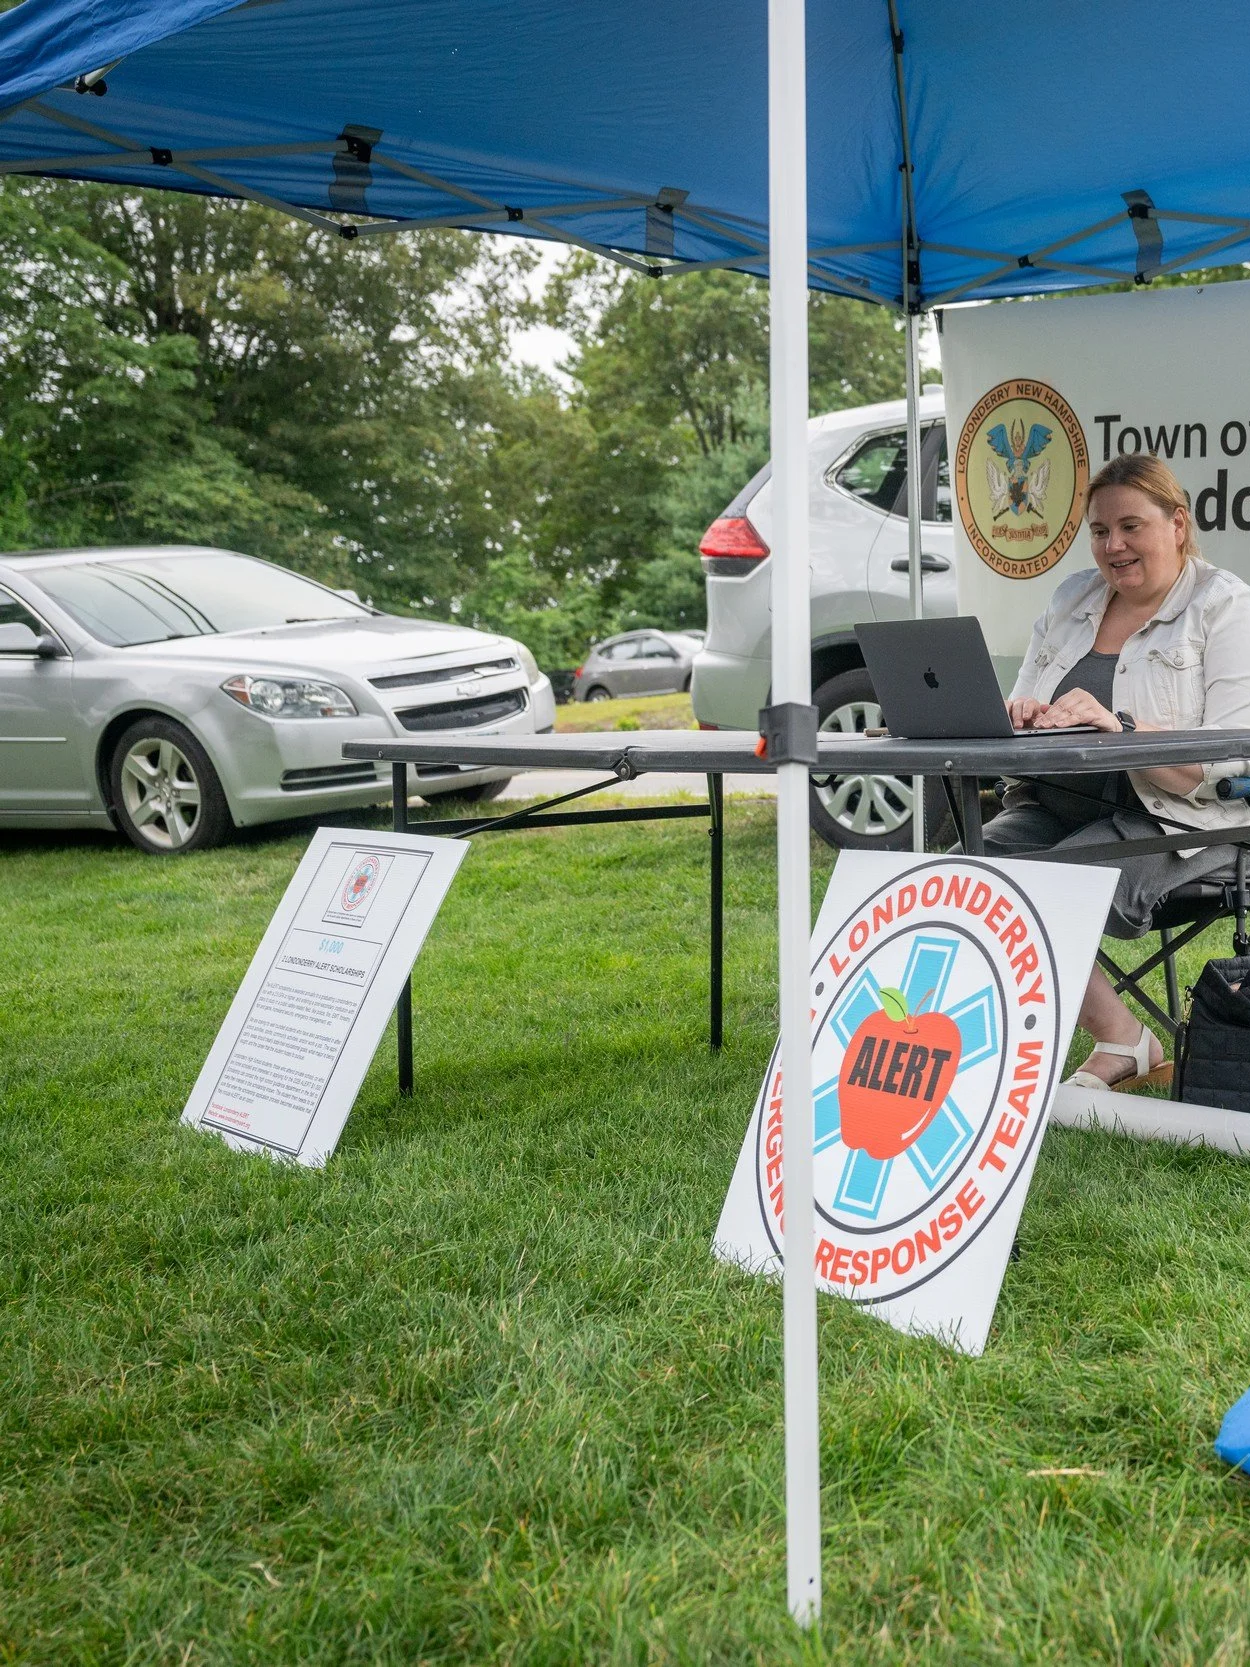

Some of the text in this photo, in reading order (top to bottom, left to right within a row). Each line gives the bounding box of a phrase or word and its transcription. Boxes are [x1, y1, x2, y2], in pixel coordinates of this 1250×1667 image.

[958, 384, 1086, 473] LONDONDERRY NEW HAMPSHIRE
[1094, 414, 1207, 461] Town
[968, 521, 1076, 575] INCORPORATED 1722
[284, 957, 315, 968] LONDONDERRY
[315, 961, 331, 971] ALERT
[330, 964, 366, 979] SCHOLARSHIPS
[318, 938, 345, 955] $1,000
[829, 875, 1046, 1006] LONDONDERRY
[847, 1036, 952, 1102] ALERT
[815, 1177, 986, 1286] RESPONSE
[978, 1041, 1045, 1173] TEAM
